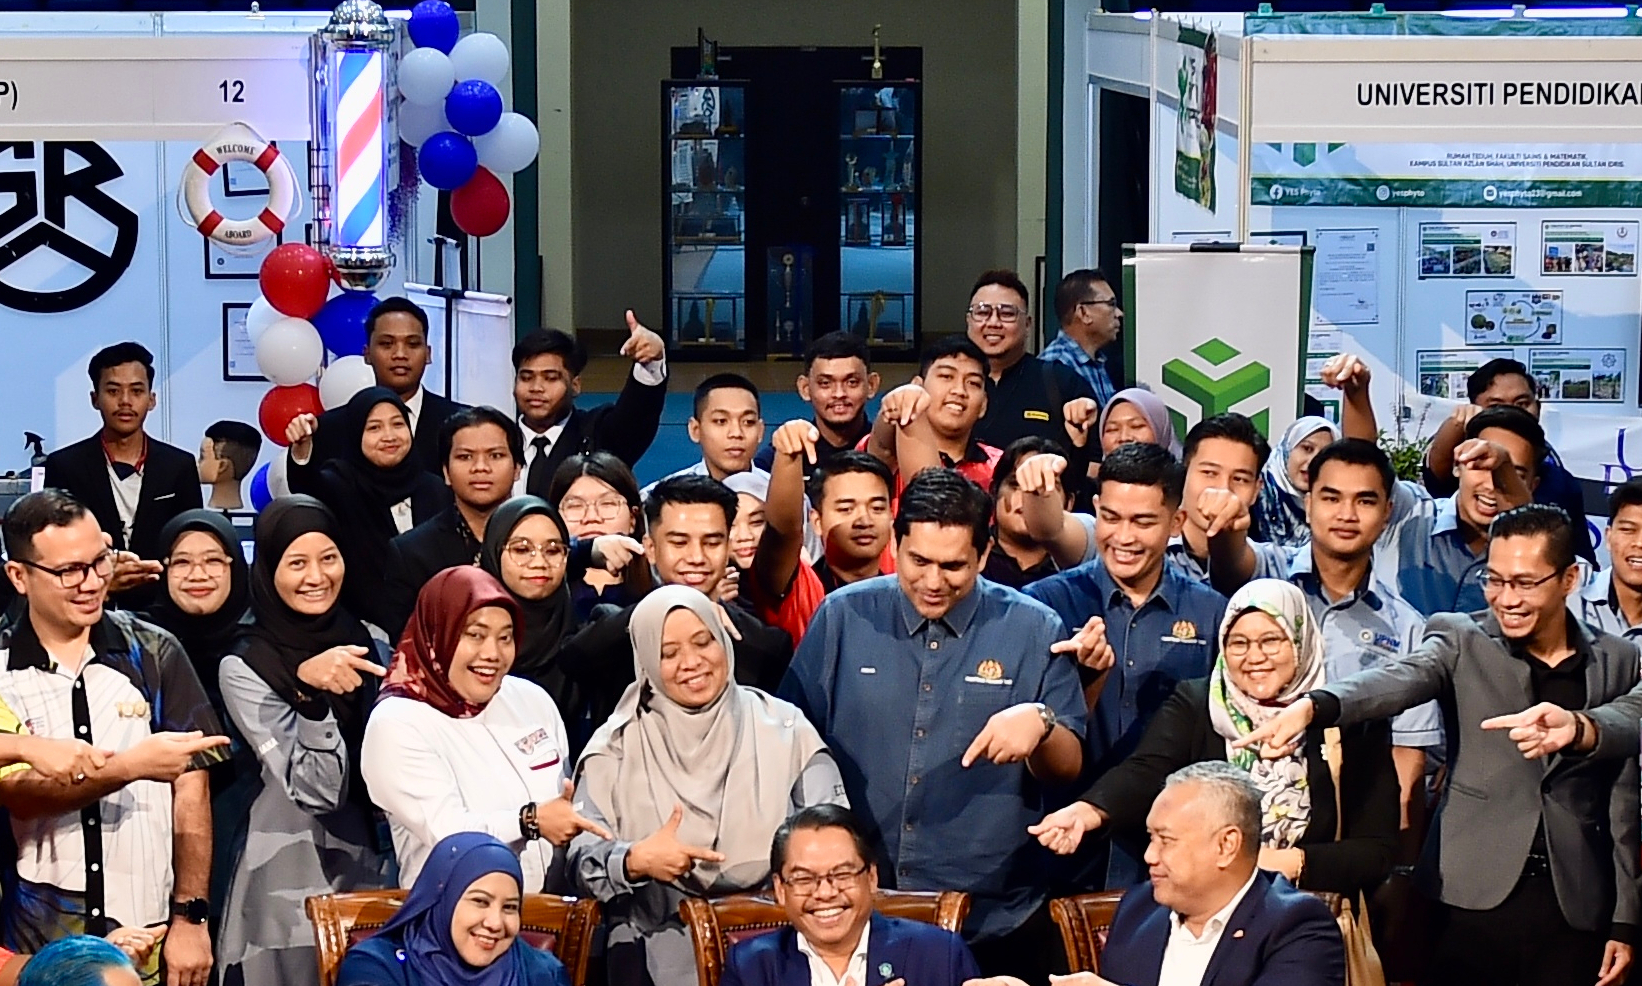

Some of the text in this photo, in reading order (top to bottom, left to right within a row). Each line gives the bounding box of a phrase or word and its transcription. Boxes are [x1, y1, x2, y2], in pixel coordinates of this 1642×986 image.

[219, 79, 245, 103] 12
[1357, 82, 1494, 106] UNIVERSITI
[216, 144, 255, 155] WELCOME
[225, 229, 252, 239] ABOARD
